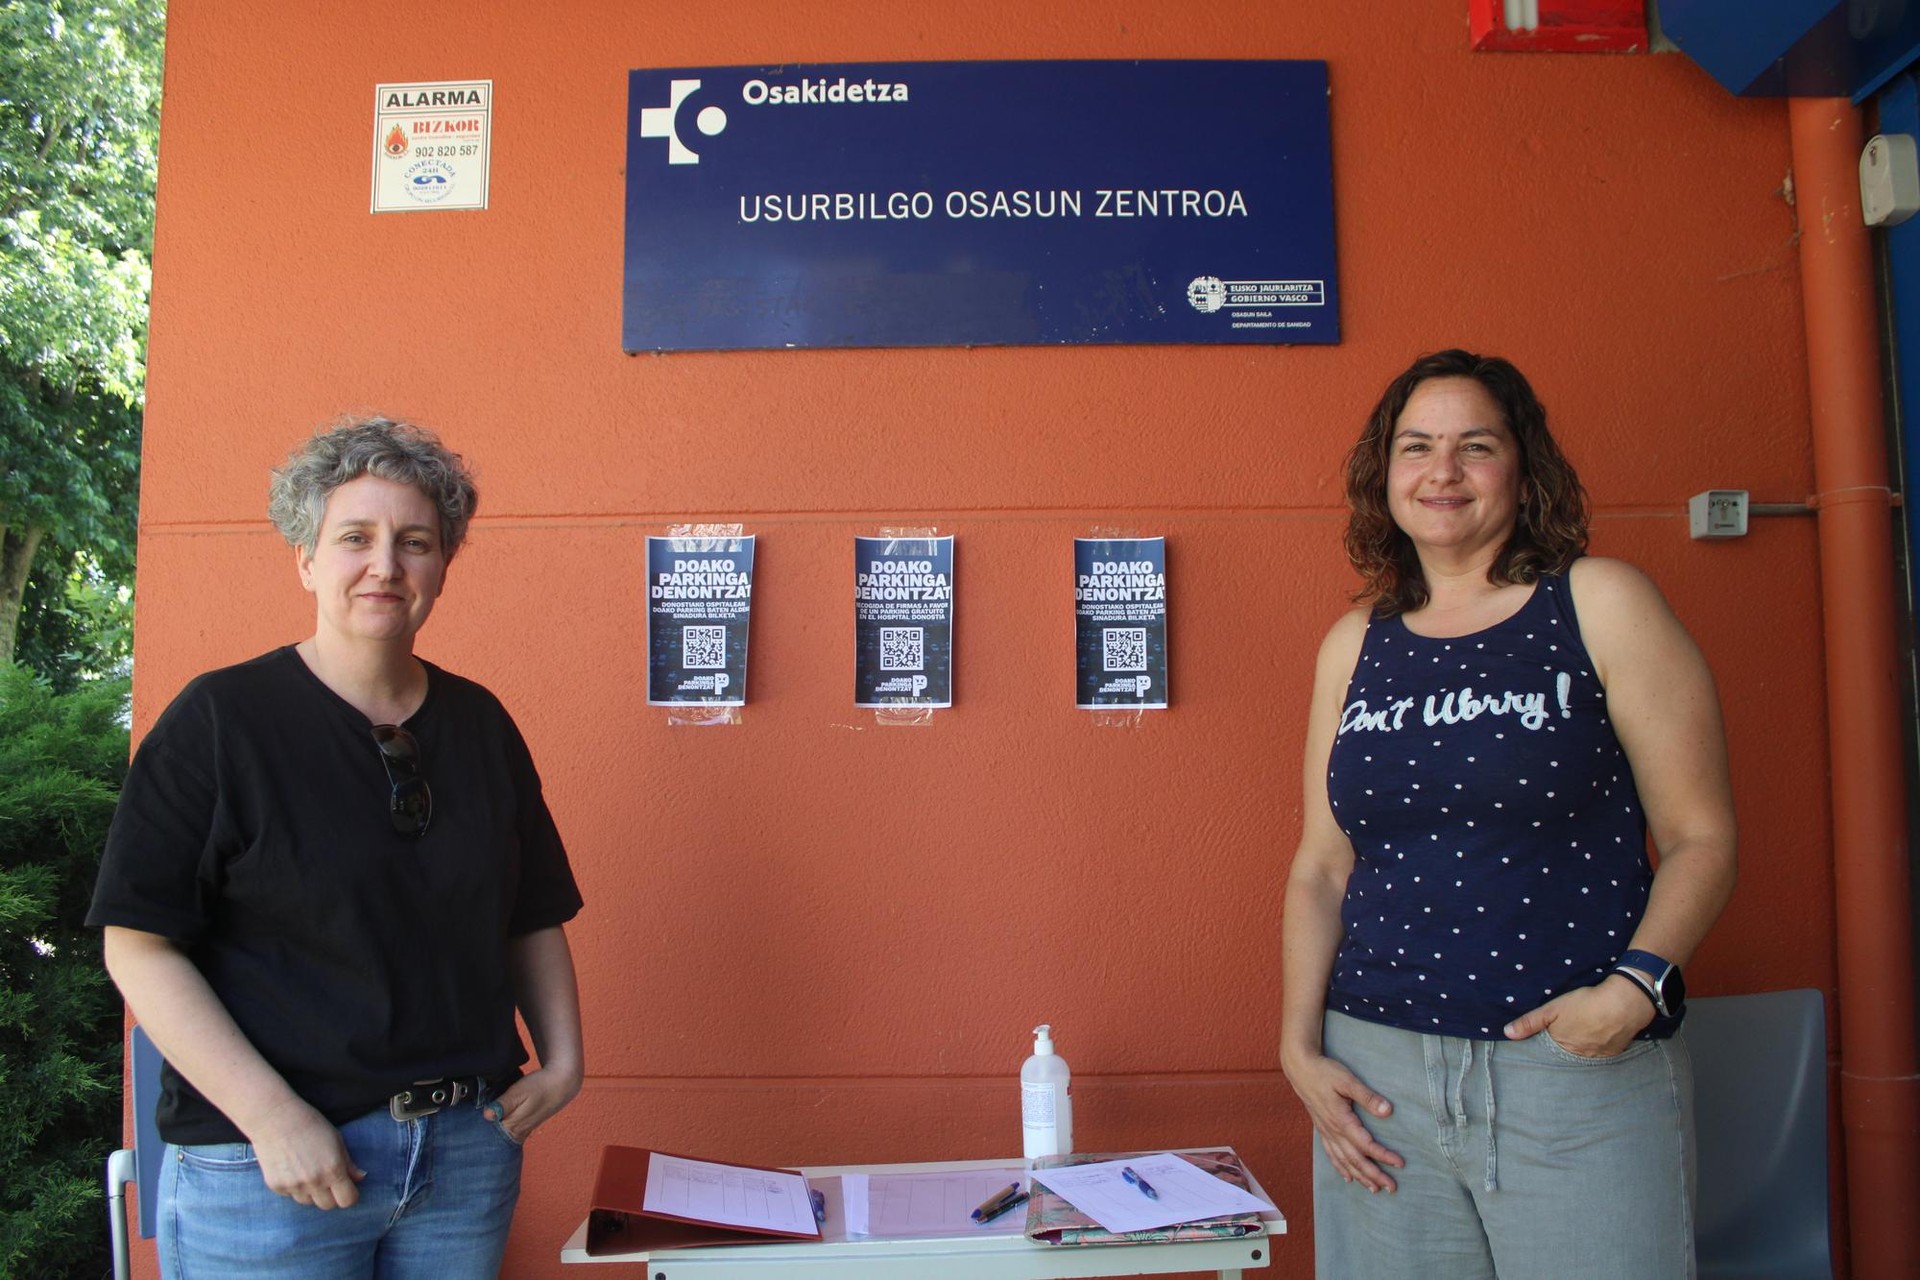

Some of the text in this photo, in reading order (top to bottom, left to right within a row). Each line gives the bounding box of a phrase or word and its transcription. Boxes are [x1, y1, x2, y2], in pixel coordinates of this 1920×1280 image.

[742, 77, 909, 105] Osakidetza
[386, 90, 481, 108] ALARMA
[413, 120, 479, 133] BIZKOR
[415, 147, 434, 157] 902
[437, 146, 456, 157] 820
[459, 145, 478, 156] 587
[404, 160, 455, 178] CONECTADA
[740, 190, 1248, 222] USURBILGO OSASUN ZENTROA
[1260, 284, 1314, 292] JAURLARITZA
[1279, 294, 1308, 302] VASCO
[675, 560, 735, 573] DOAKO
[871, 561, 932, 574] DOAKO
[1092, 561, 1154, 574] DOAKO
[659, 572, 748, 586] PARKINGA
[859, 573, 947, 587] PARKINGA
[1079, 573, 1165, 588] PARKINGA
[1075, 586, 1165, 601] DENONTZA
